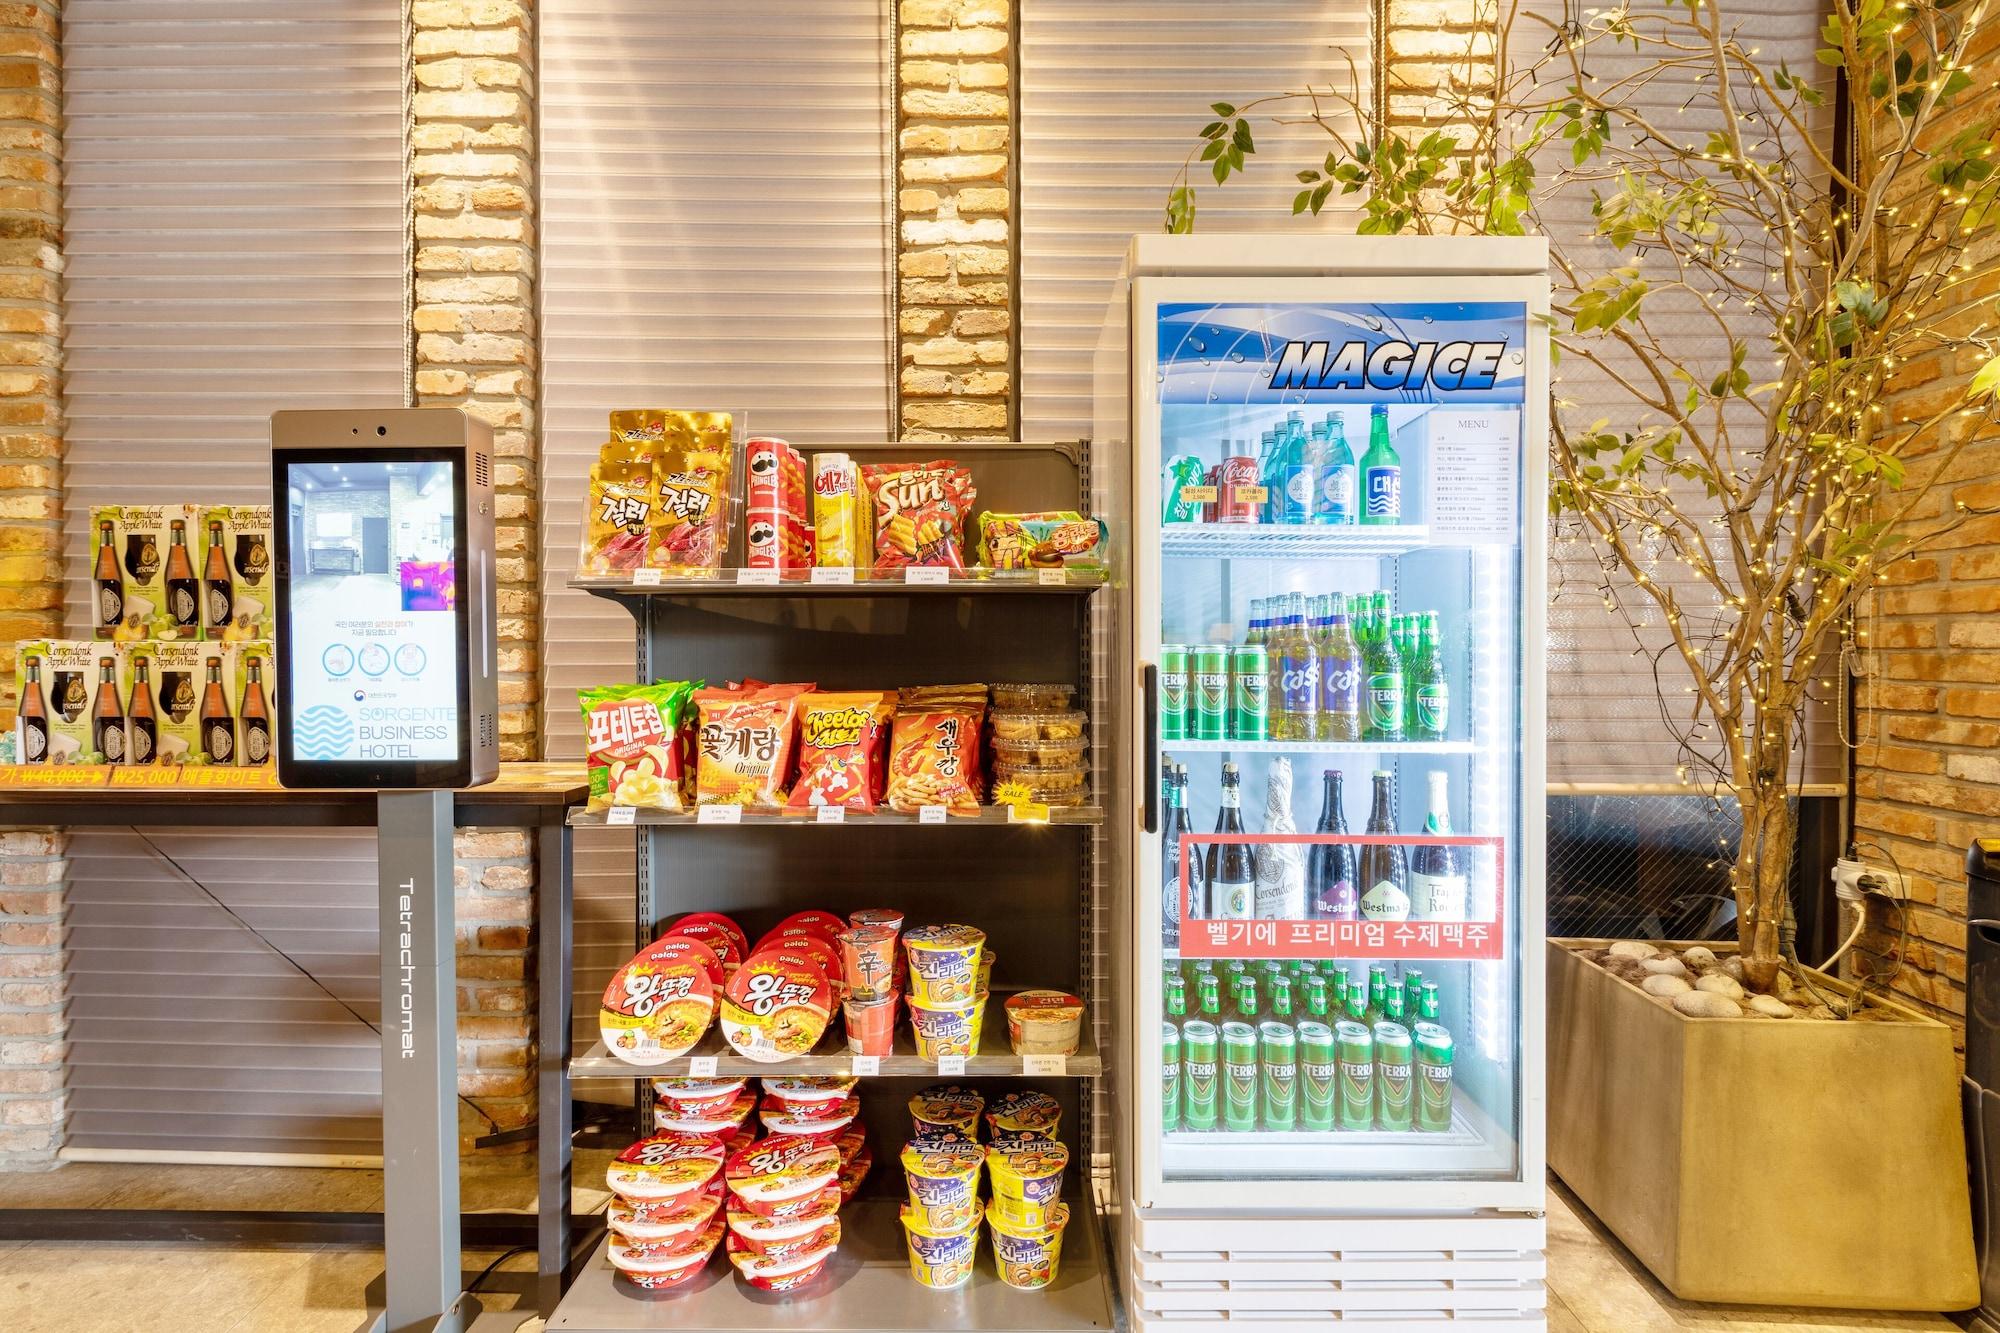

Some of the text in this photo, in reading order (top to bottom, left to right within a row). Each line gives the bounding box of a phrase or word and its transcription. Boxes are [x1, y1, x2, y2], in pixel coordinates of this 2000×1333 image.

[1269, 341, 1506, 391] MAGICE
[1458, 420, 1488, 428] MENU
[660, 484, 711, 519] 질러
[878, 478, 945, 529] Sun
[600, 495, 650, 529] 질러
[360, 726, 448, 739] BUSINESS
[588, 703, 665, 753] 포테토칩
[360, 744, 418, 758] HOTEL
[615, 740, 647, 753] ORIGINAL
[701, 725, 780, 761] 꽃게랑
[936, 718, 960, 776] 새우깡
[113, 769, 176, 784] ₩25,000
[183, 769, 261, 784] 애플화이트
[683, 926, 708, 934] paldo
[1208, 922, 1489, 948] 벨기에 프리미엄 수제맥주
[651, 952, 679, 961] paldo
[665, 943, 690, 951] paldo
[400, 877, 416, 1059] Tetrachromat
[780, 955, 805, 966] paldo
[858, 950, 883, 985] 辛
[920, 960, 965, 980] 진라면
[621, 973, 696, 1018] 왕뚜껑
[742, 974, 817, 1017] 왕뚜껑
[919, 1020, 963, 1041] 진라면
[1186, 1061, 1217, 1075] TERRA
[1226, 1063, 1257, 1076] TERRA
[1265, 1063, 1297, 1076] TERRA
[1304, 1063, 1335, 1077] TERRA
[1342, 1063, 1373, 1076] TERRA
[1380, 1063, 1411, 1077] TERRA
[1421, 1063, 1452, 1078] TERRA
[634, 1143, 710, 1166] 왕뚜껑
[916, 1141, 976, 1155] 진라면
[997, 1140, 1057, 1155] 진라면
[749, 1141, 815, 1174] 왕뚜껑
[920, 1186, 965, 1207] 진라면
[922, 1242, 969, 1264] 진라면
[1000, 1245, 1043, 1264] 진라면
